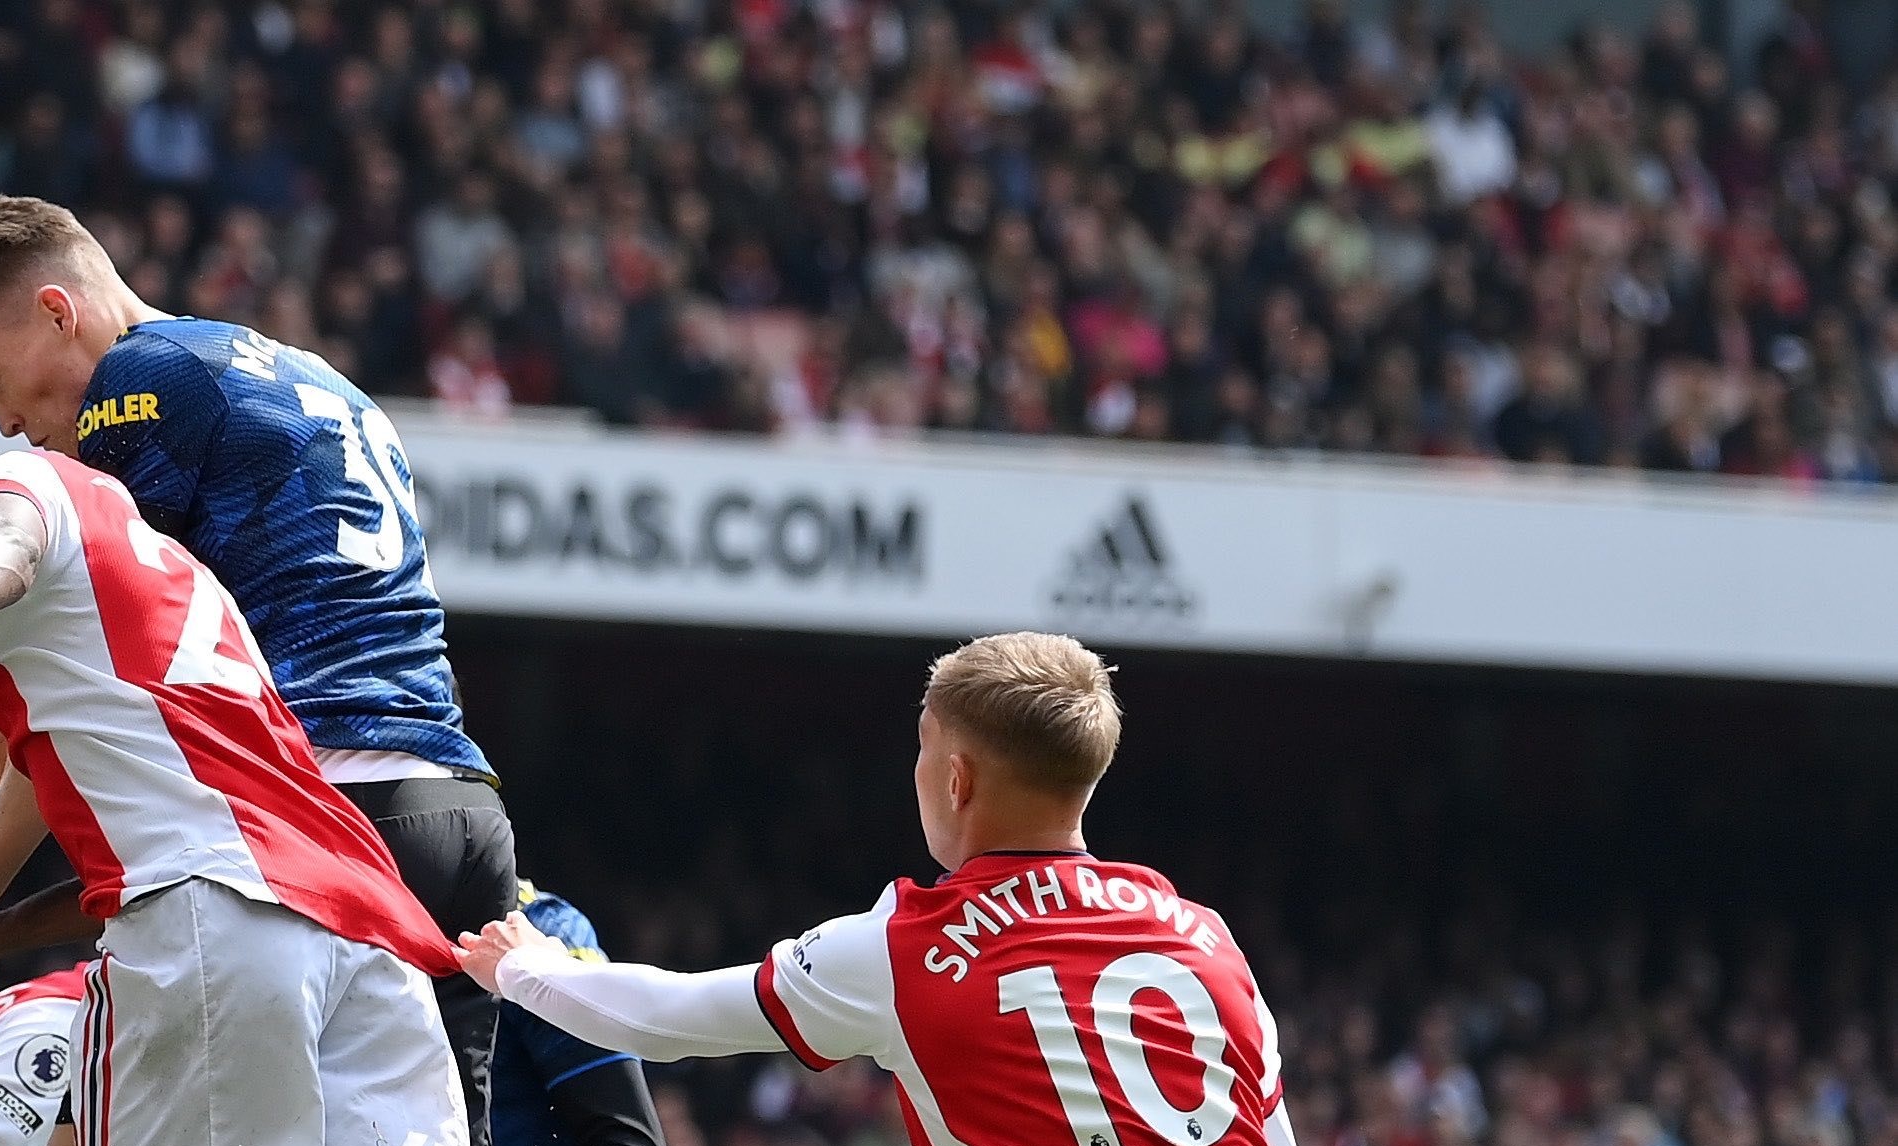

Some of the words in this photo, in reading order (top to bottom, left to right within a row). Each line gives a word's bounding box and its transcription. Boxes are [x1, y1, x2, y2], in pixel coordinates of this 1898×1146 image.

[415, 473, 927, 583] DIDAS.COM
[924, 866, 1067, 982] SMITH
[1075, 866, 1220, 957] ROWE
